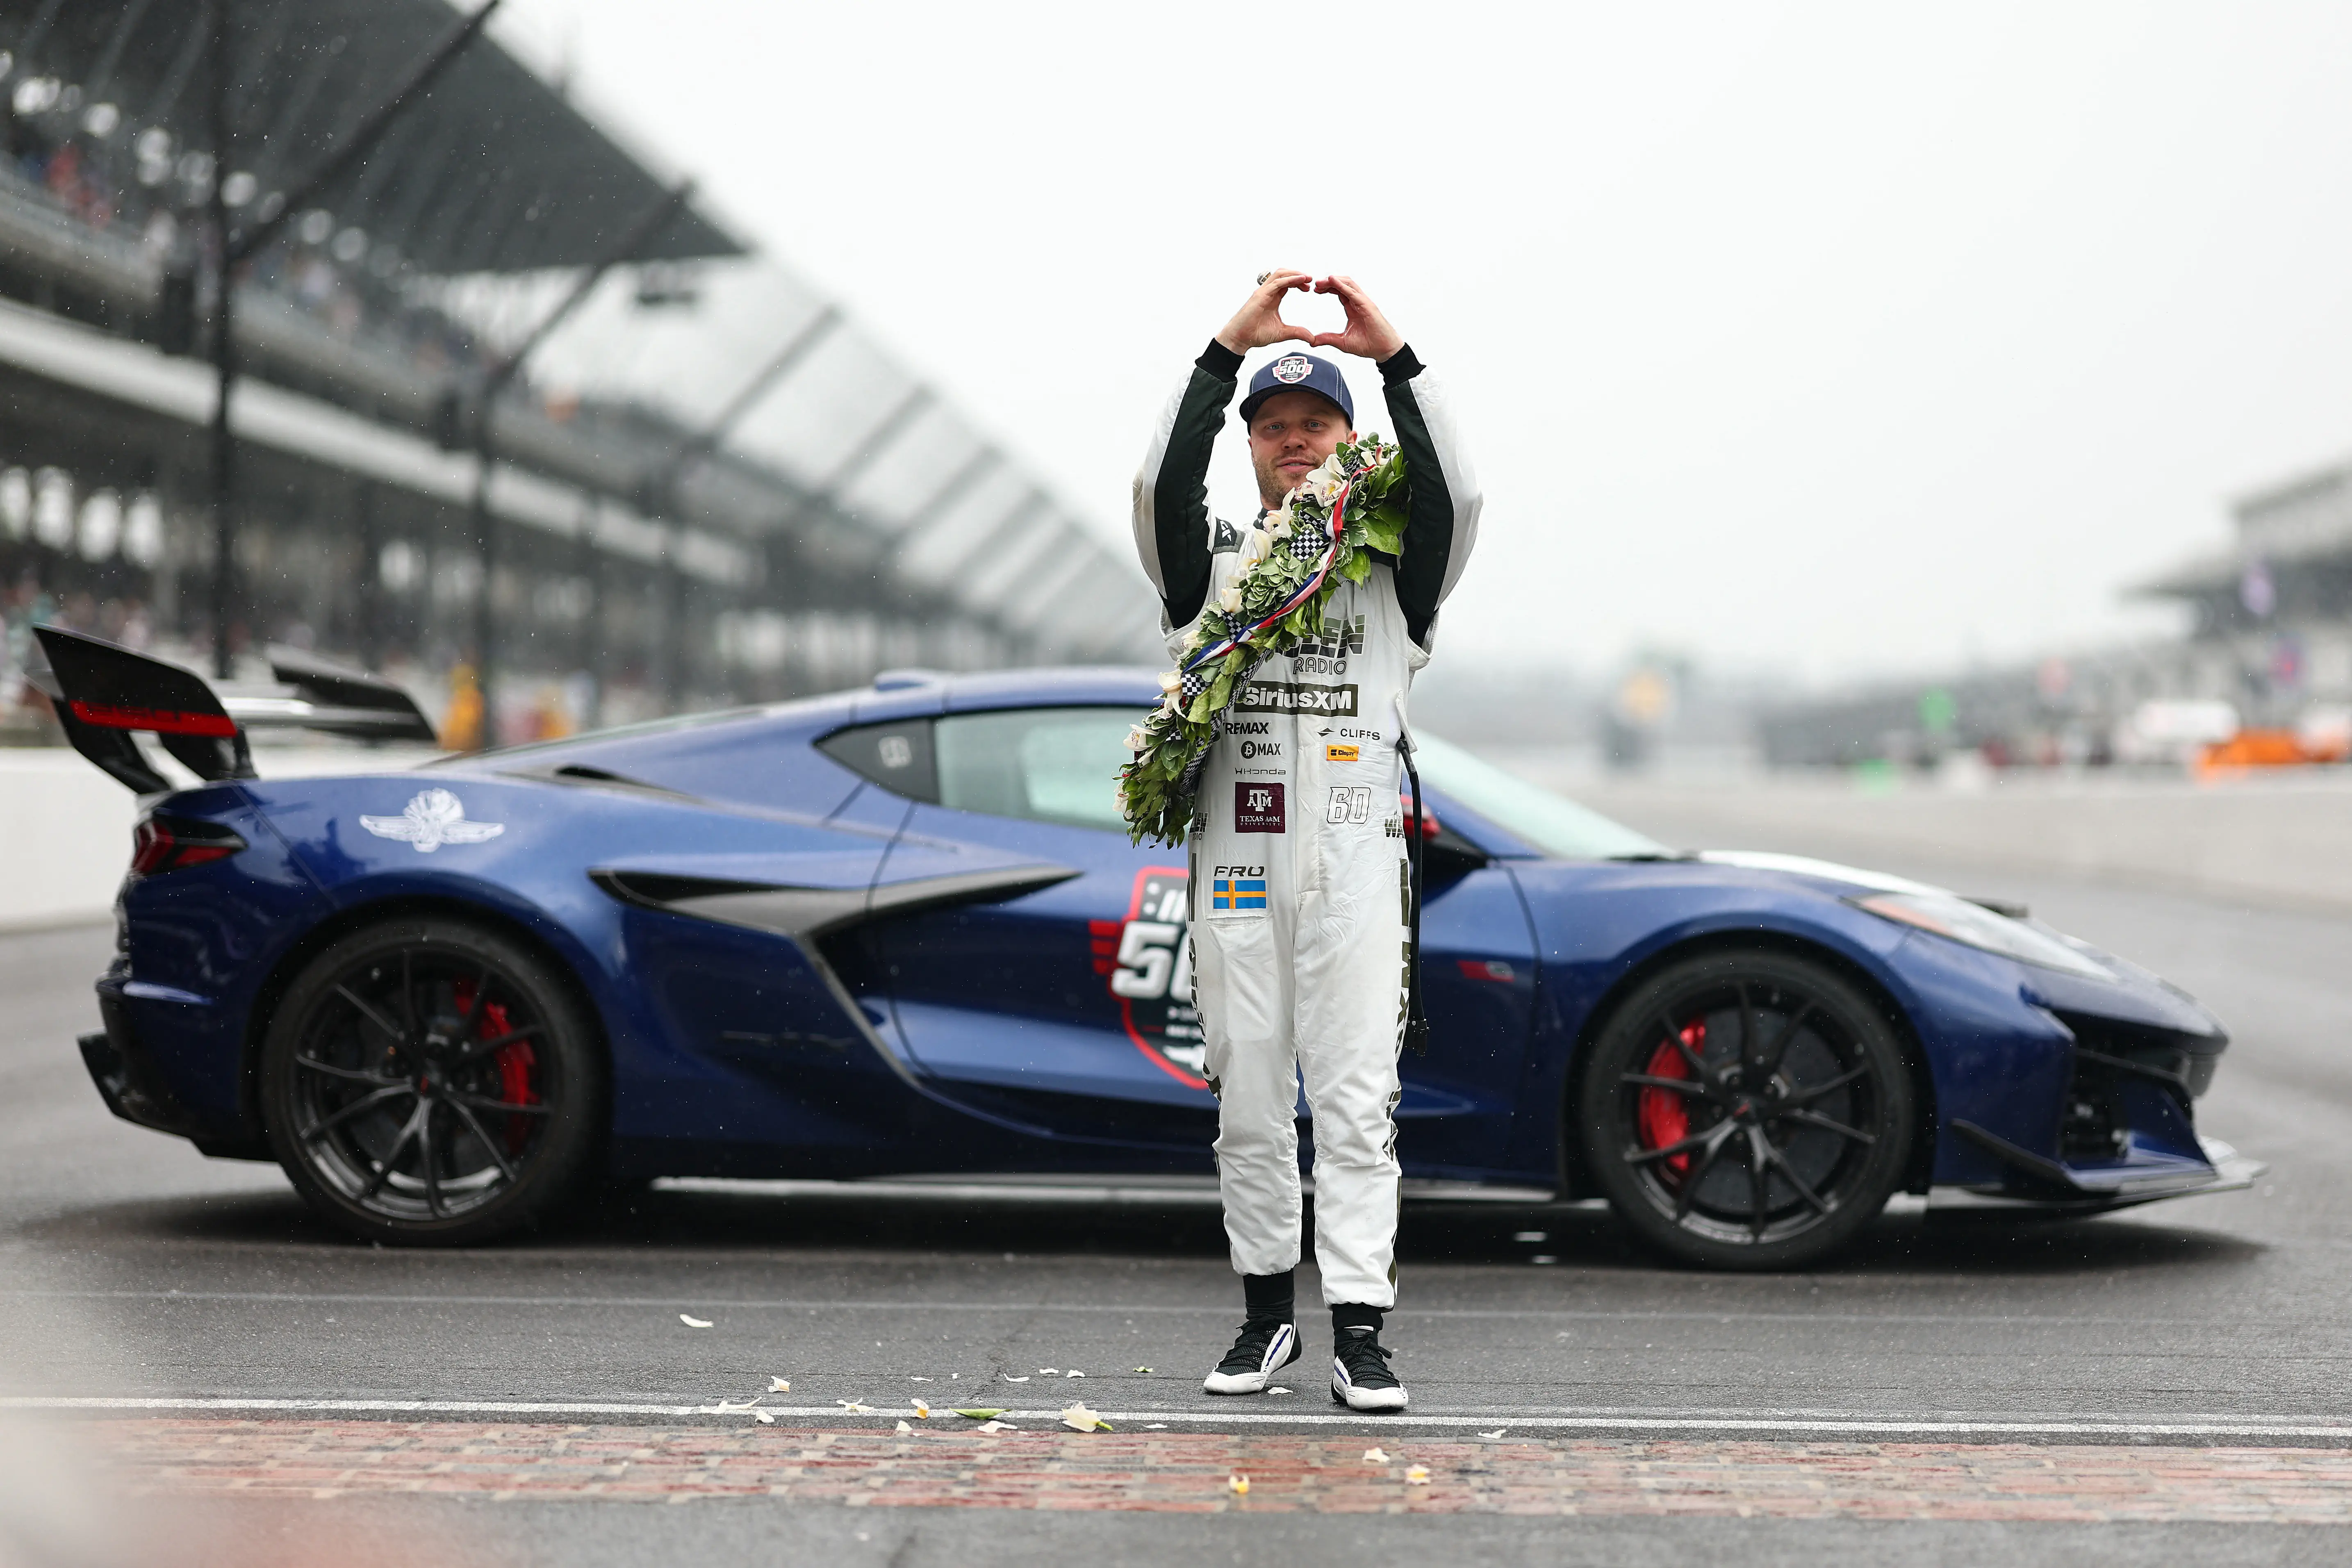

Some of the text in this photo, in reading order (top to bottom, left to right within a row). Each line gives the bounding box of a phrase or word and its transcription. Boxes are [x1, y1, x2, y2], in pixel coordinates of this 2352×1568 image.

[1278, 364, 1307, 375] 500
[1293, 657, 1347, 675] RADIO
[1243, 687, 1351, 710] SiriusXM
[1225, 722, 1269, 735] REMAX
[1340, 728, 1380, 740] CLIFFS
[1257, 743, 1281, 756] MAX
[1327, 787, 1371, 824] 60
